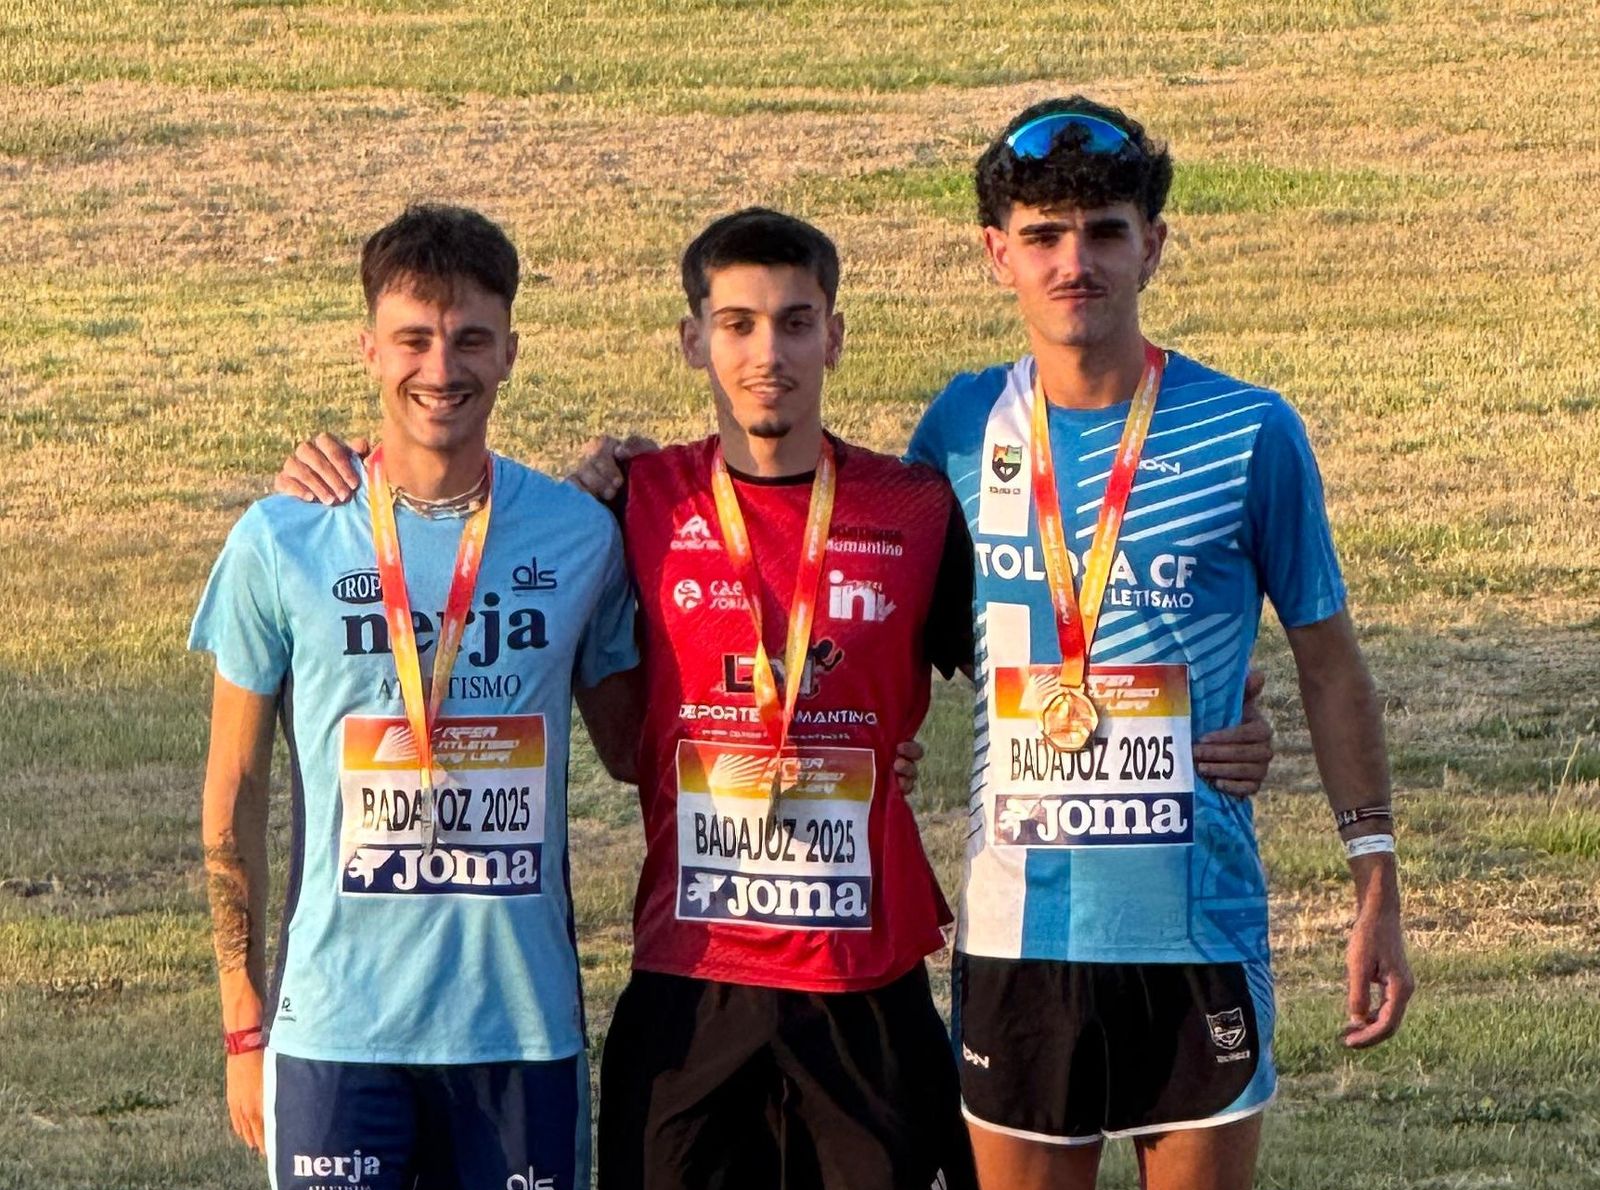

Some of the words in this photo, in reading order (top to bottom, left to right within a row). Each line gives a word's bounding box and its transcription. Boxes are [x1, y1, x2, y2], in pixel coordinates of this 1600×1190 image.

[334, 574, 382, 600] TROP
[1150, 554, 1198, 588] CF
[1108, 588, 1195, 609] LETISMO
[376, 673, 522, 700] ATISMO
[679, 704, 760, 723] DEPORTE
[1119, 735, 1174, 781] 2025
[361, 786, 472, 833] BADAOZ
[481, 786, 530, 833] 2025
[694, 811, 797, 863] BADAJOZ
[805, 818, 856, 864] 2025
[293, 1149, 380, 1184] nerja
